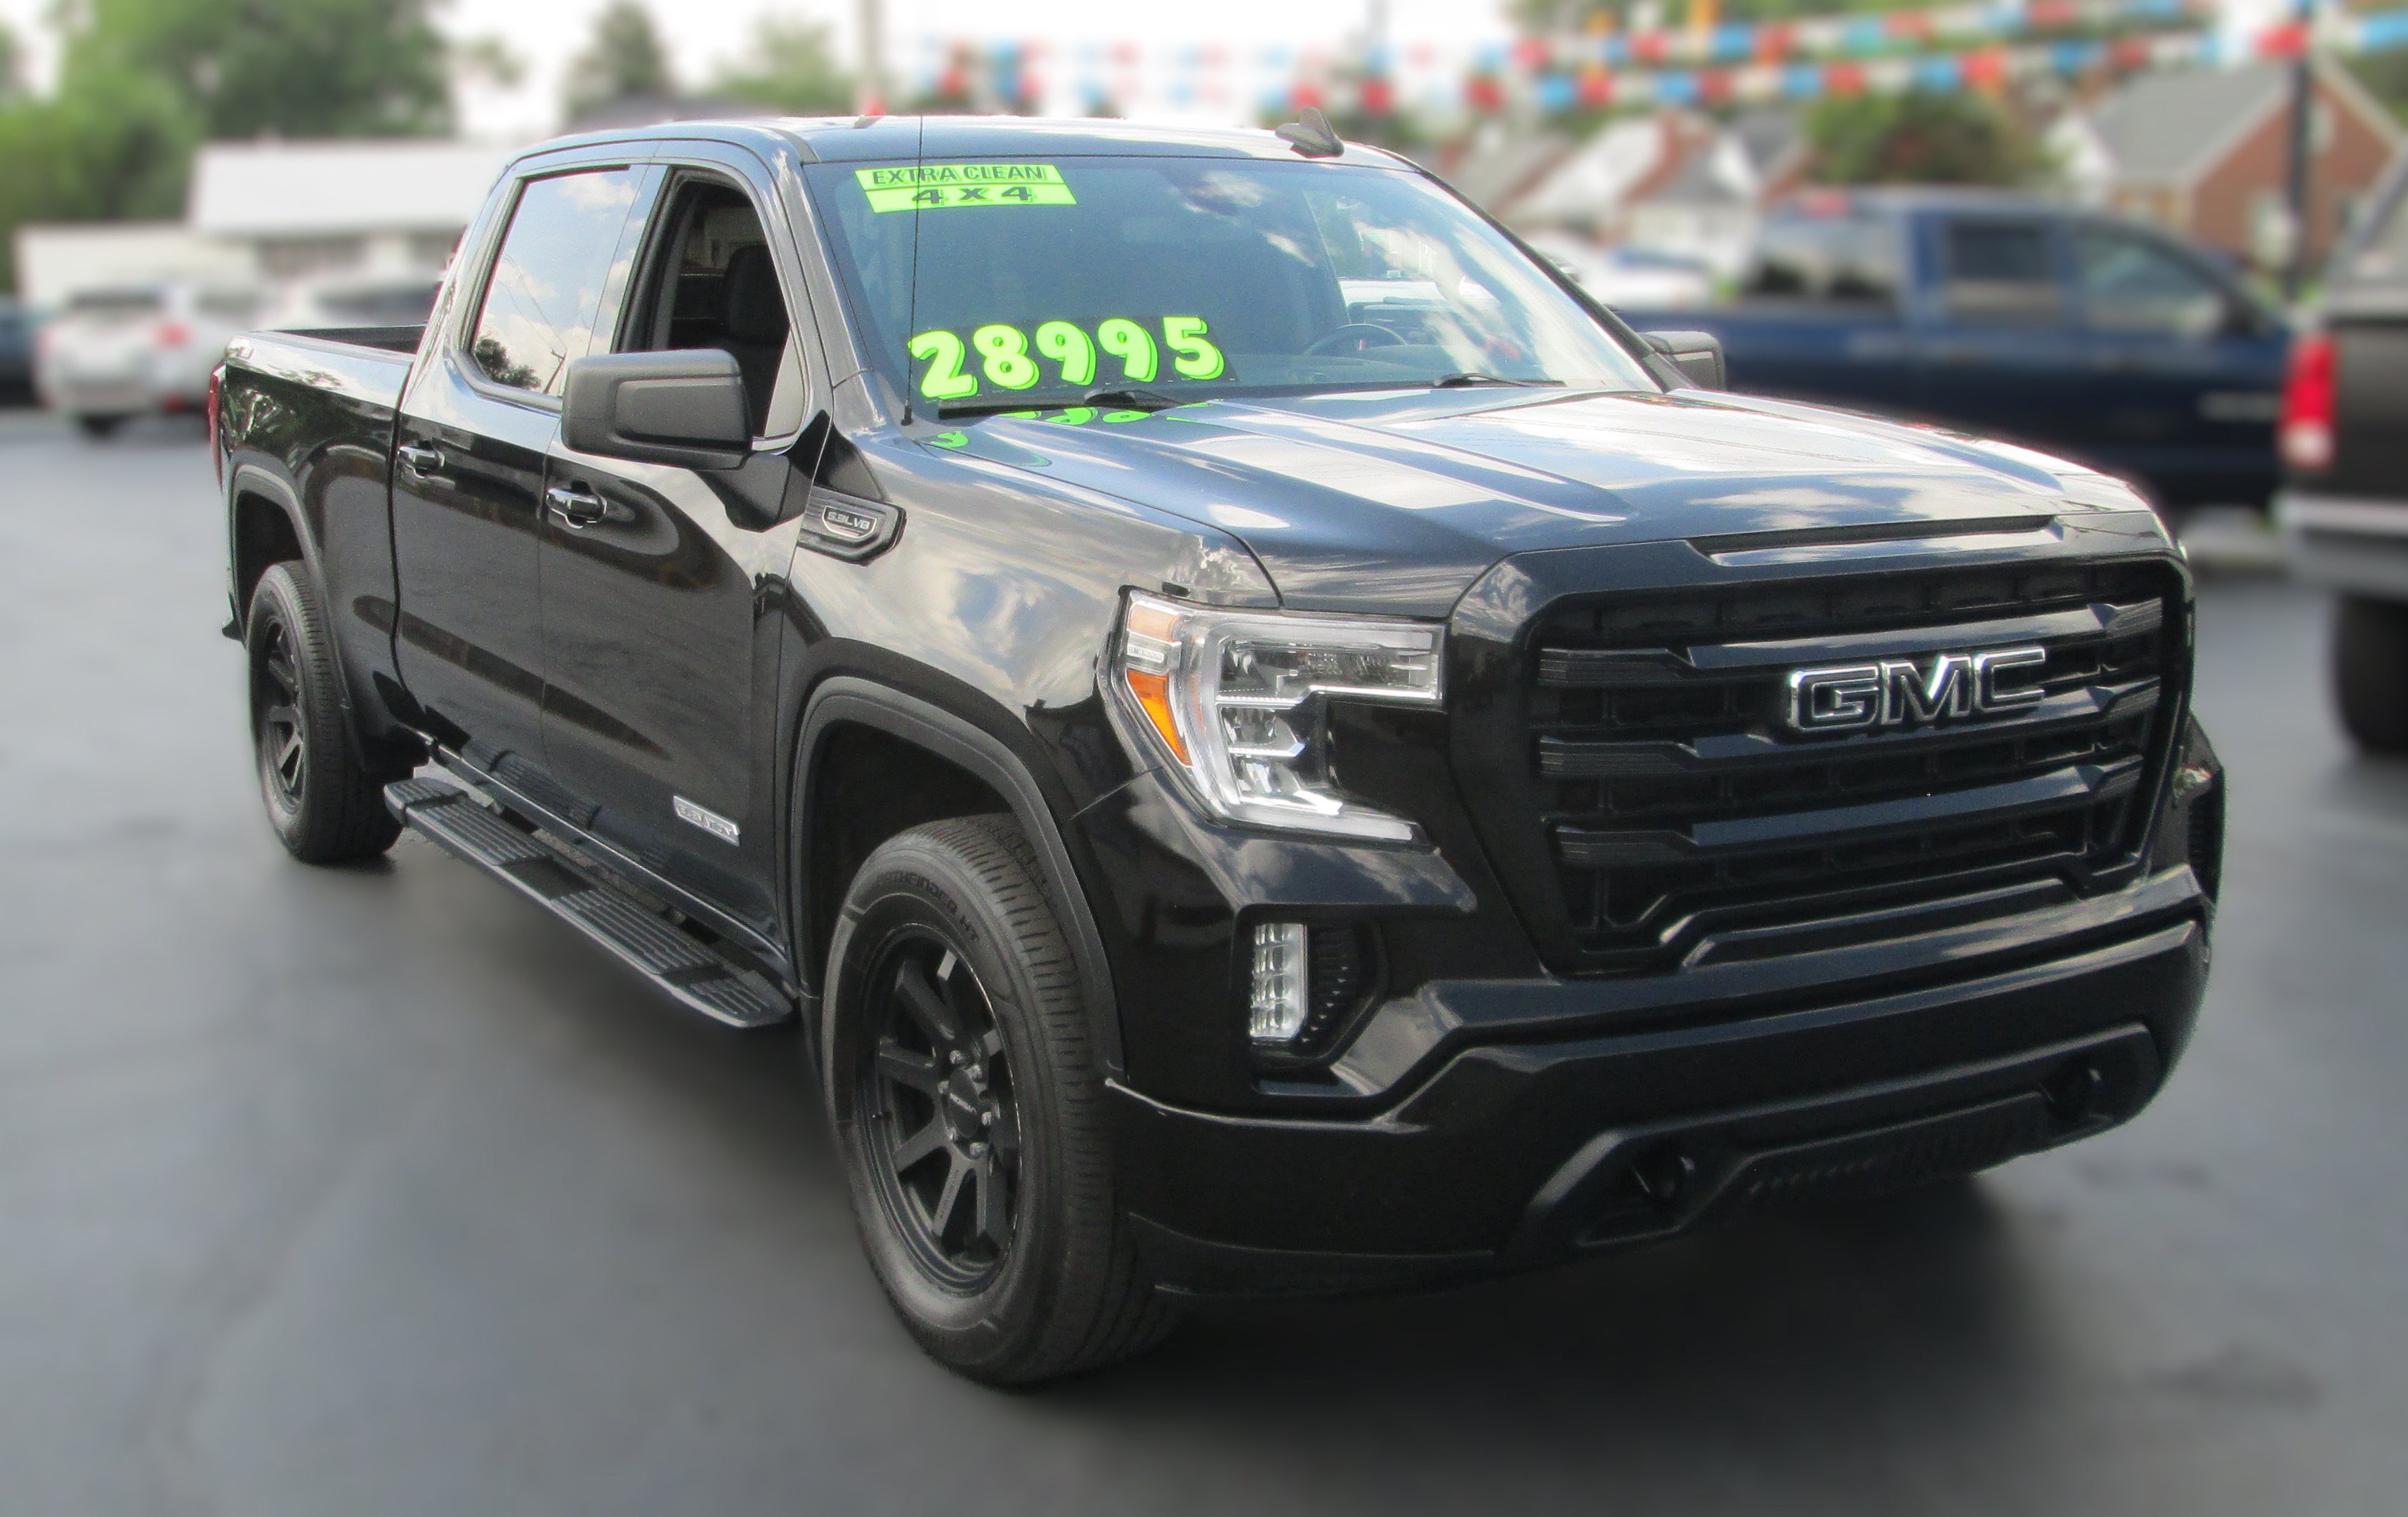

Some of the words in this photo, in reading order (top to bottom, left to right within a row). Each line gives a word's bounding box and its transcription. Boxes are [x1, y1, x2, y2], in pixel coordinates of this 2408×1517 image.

[872, 166, 959, 185] EXTRA
[963, 166, 1045, 181] CLEAN
[908, 316, 1224, 400] 28995
[1787, 646, 2046, 732] GMC
